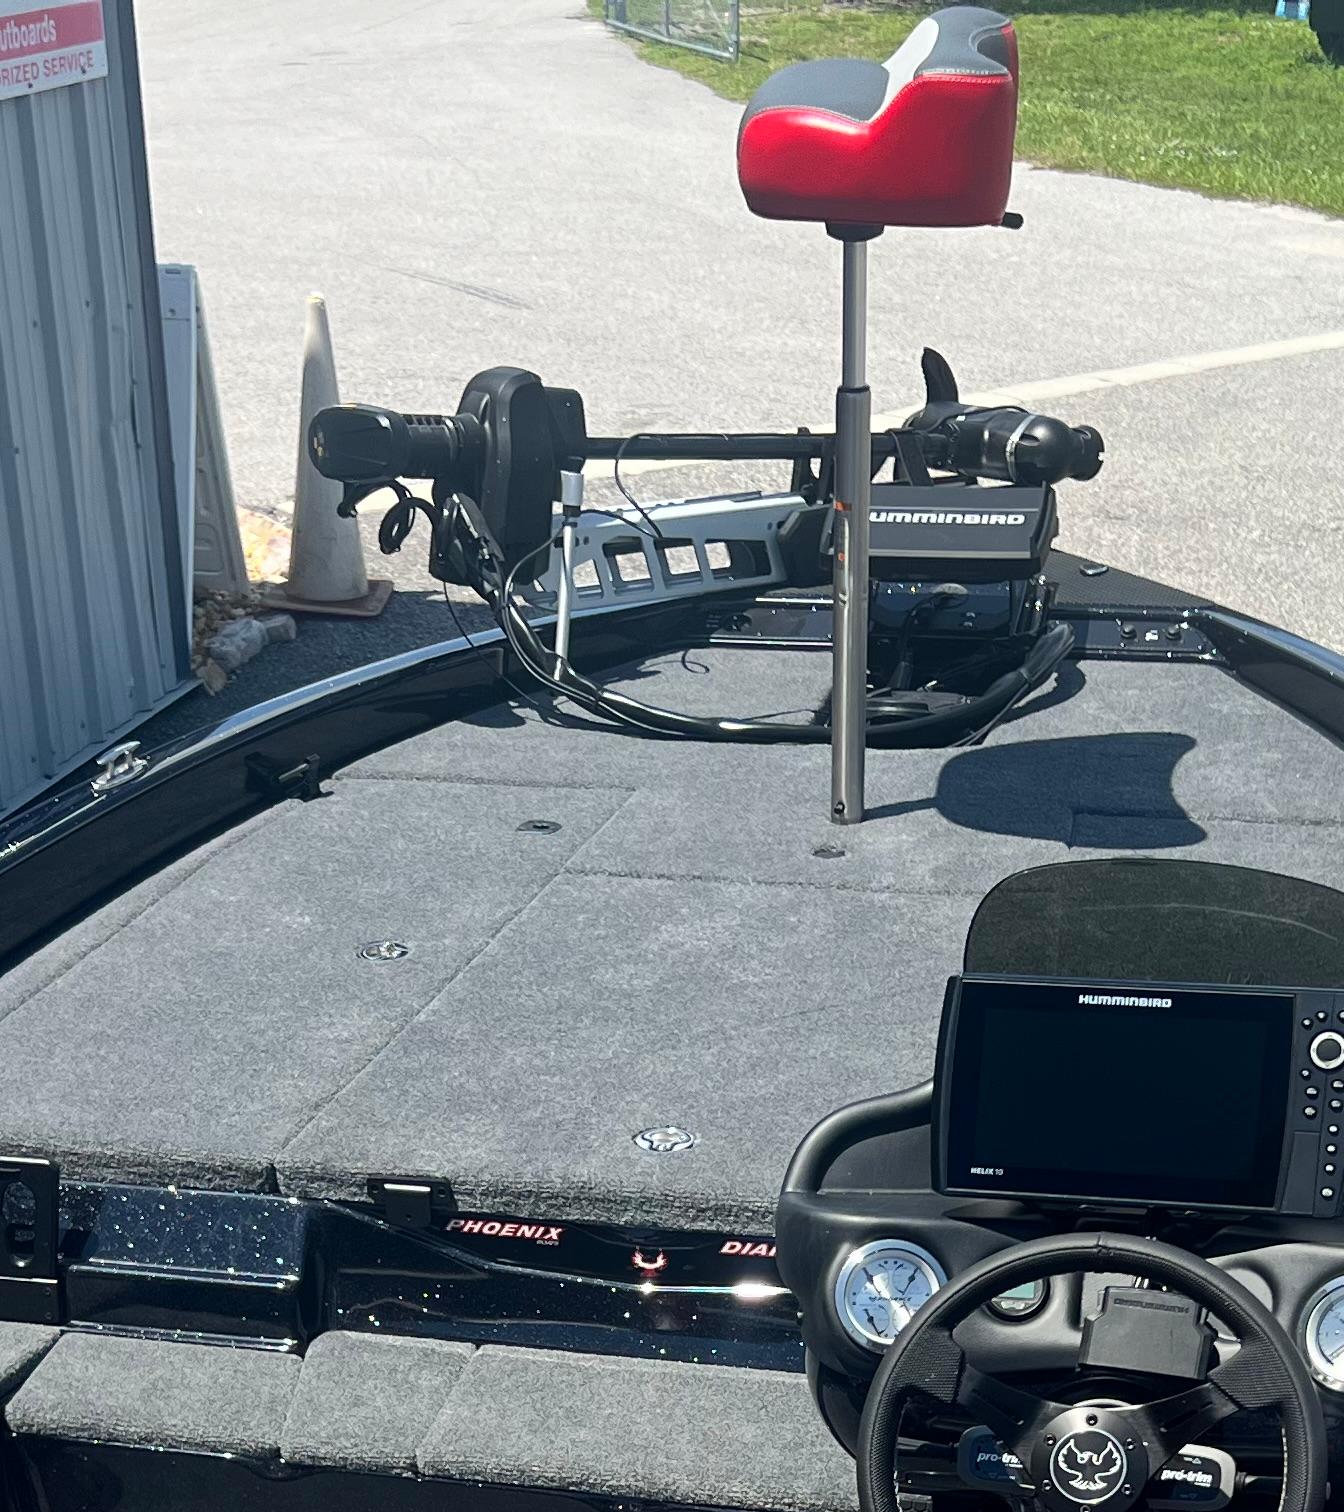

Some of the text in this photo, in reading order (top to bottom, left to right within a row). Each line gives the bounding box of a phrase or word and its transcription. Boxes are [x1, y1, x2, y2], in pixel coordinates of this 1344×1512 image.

[43, 50, 95, 78] SERVICE
[869, 511, 1026, 525] UMMINBIRD
[1078, 994, 1172, 1008] HUMMINBIRD
[446, 1219, 563, 1240] PHOENIX
